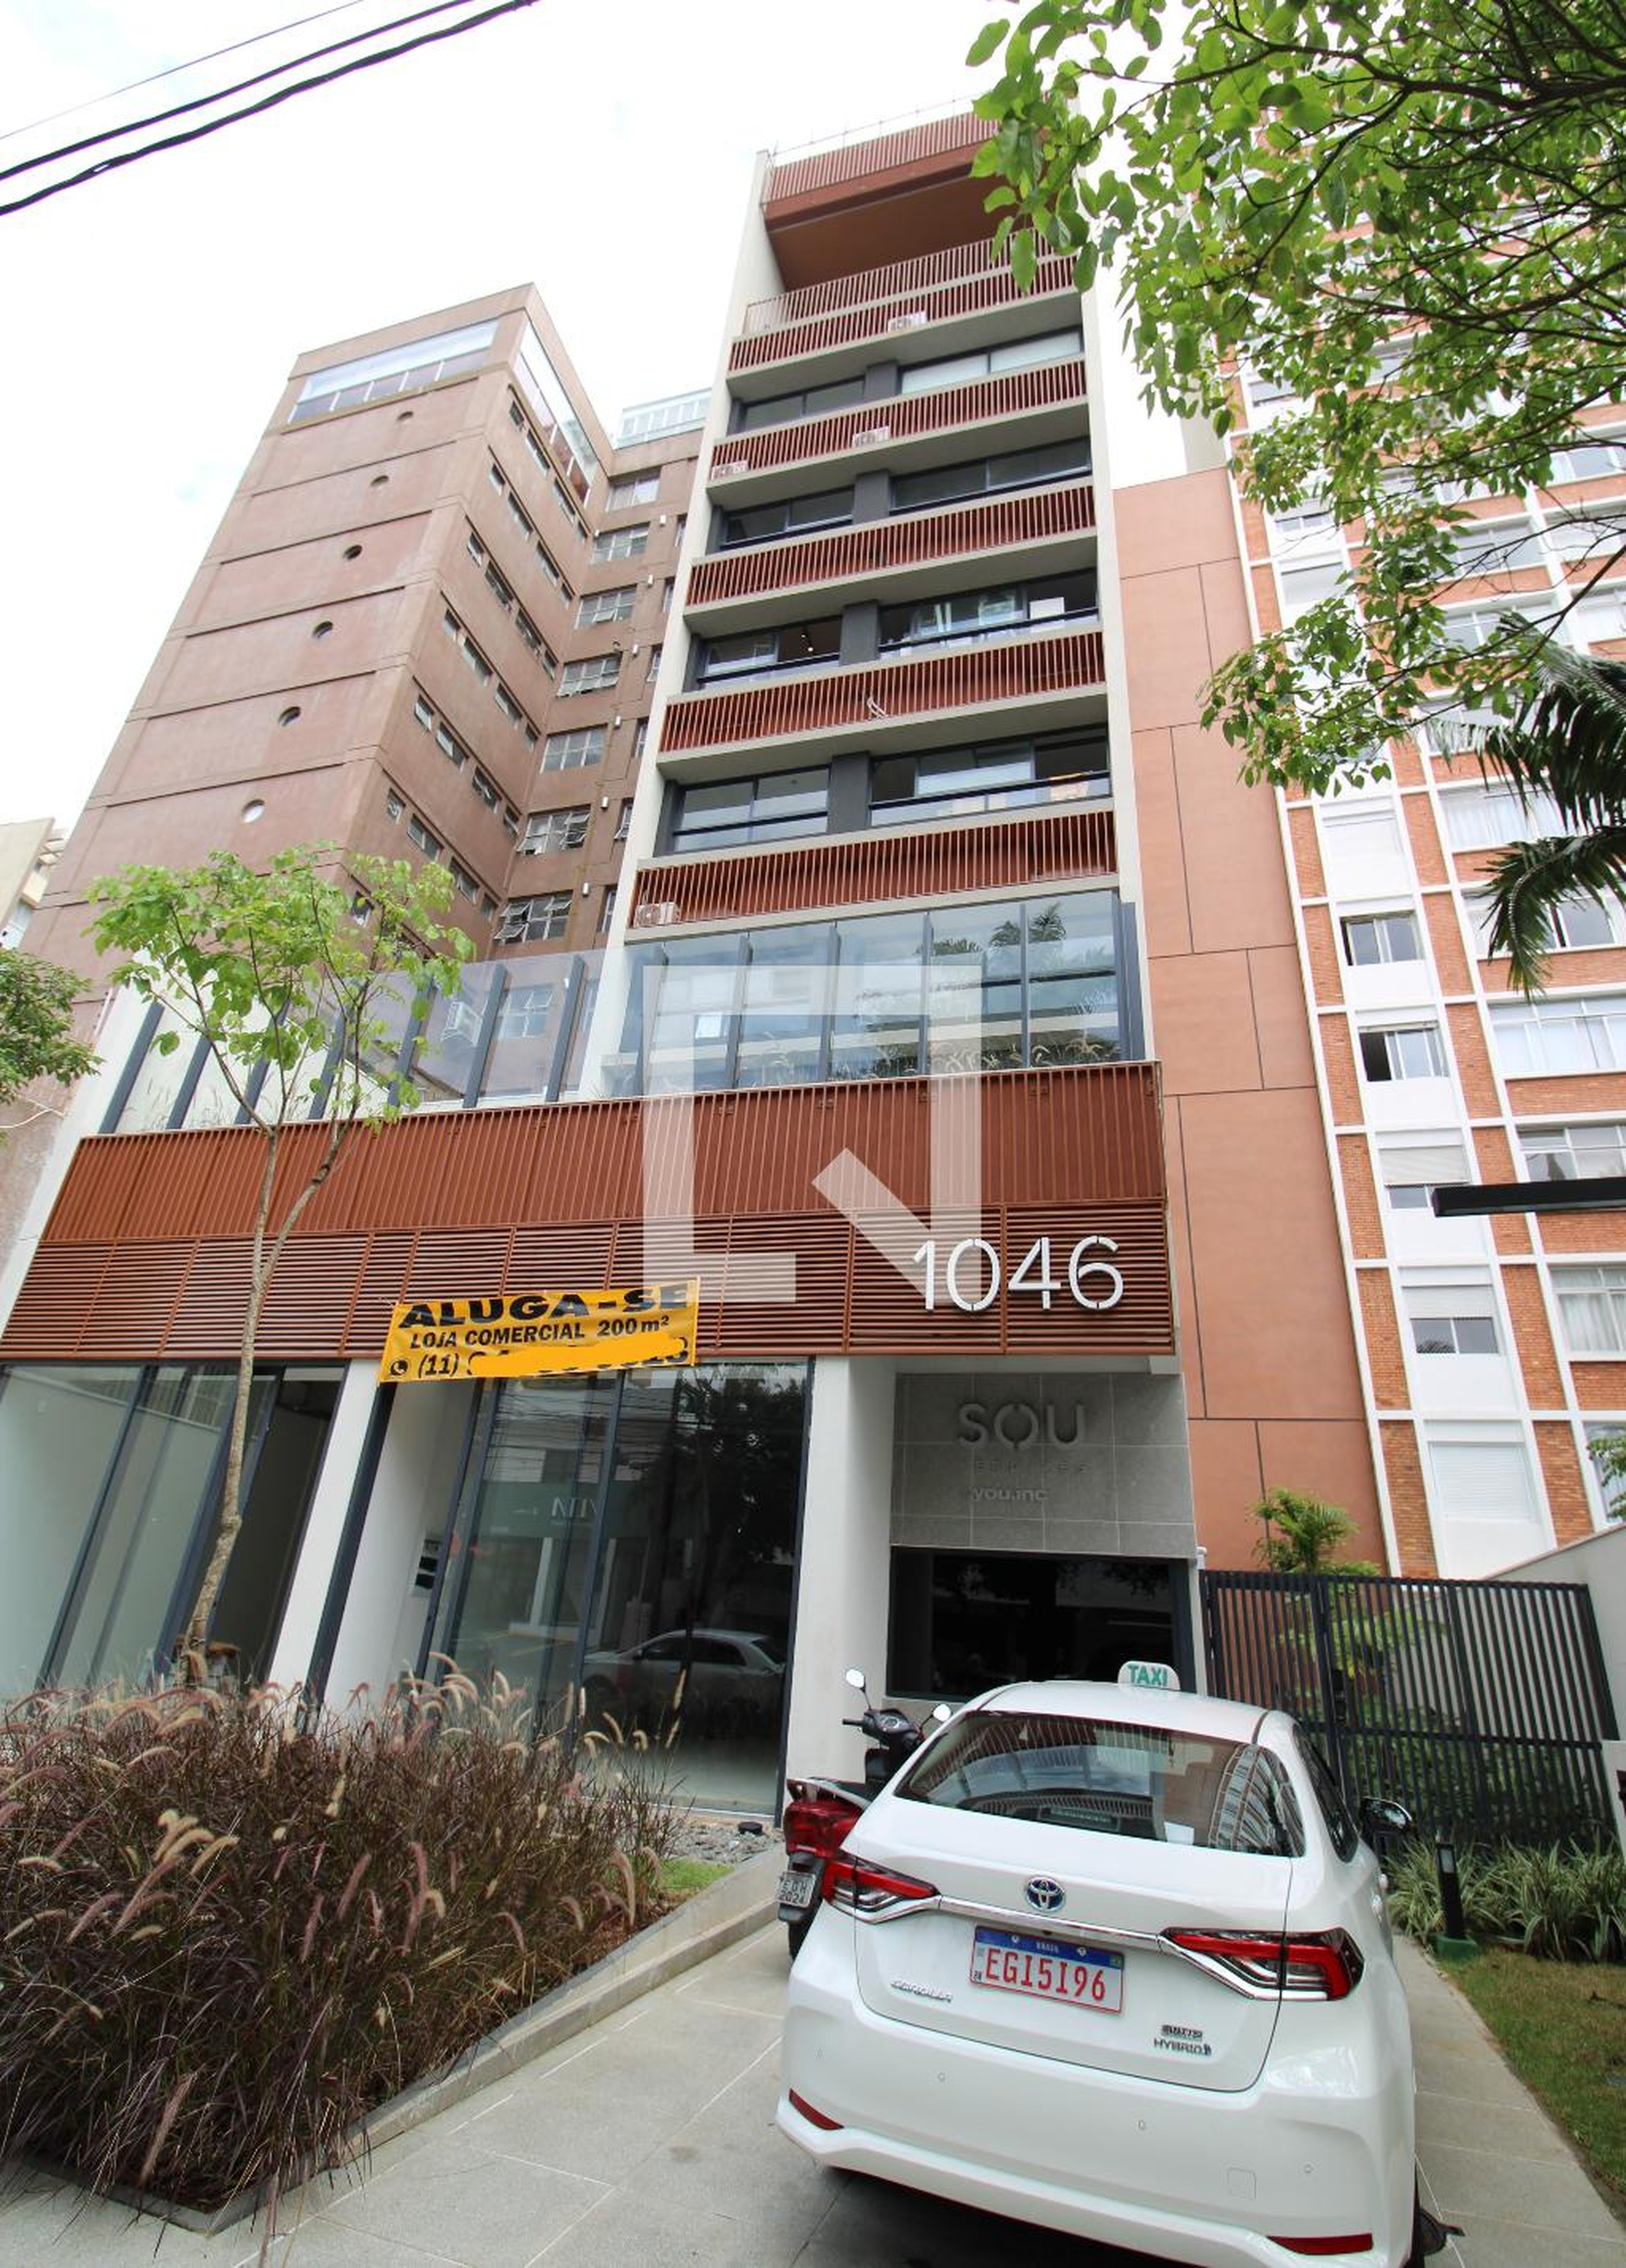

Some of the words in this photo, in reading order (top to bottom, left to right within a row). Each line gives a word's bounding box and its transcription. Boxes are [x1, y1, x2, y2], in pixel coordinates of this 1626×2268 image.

[913, 1235, 1124, 1312] 1046
[398, 1284, 687, 1328] ALUGA-SE
[410, 1332, 457, 1349] LOJA
[465, 1323, 585, 1346] COMERCIAL
[597, 1318, 637, 1337] 200
[959, 1402, 1085, 1450] SOU
[1127, 1664, 1168, 1687] TAXI
[986, 1947, 1106, 2001] EGI5I96
